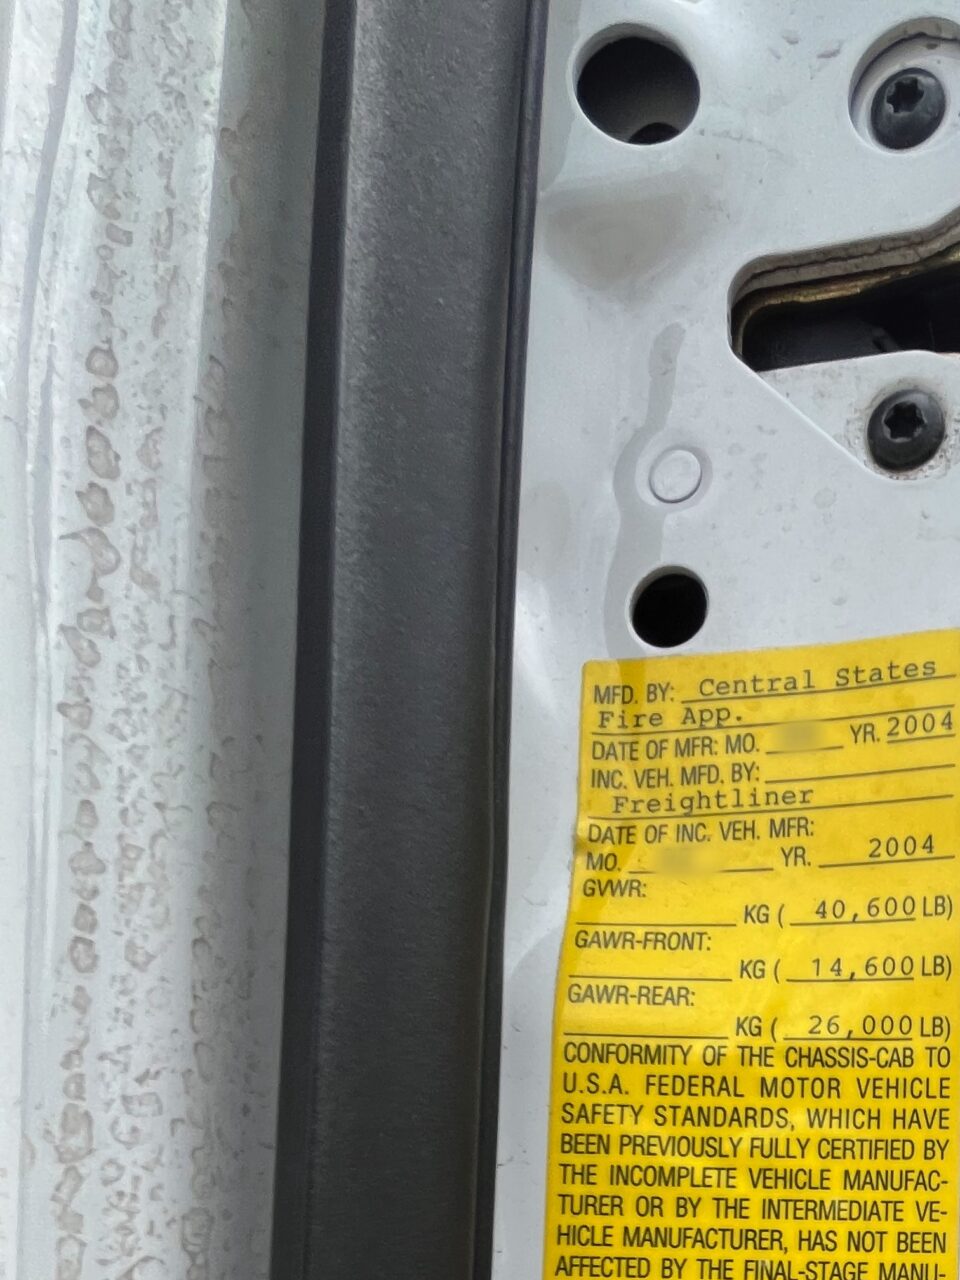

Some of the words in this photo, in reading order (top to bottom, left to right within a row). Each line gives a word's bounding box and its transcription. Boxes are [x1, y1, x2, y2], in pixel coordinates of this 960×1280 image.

[594, 685, 638, 705] MFD.
[647, 683, 674, 702] BY:
[699, 670, 816, 696] Central
[836, 660, 936, 686] States
[599, 710, 663, 729] Fire
[682, 708, 743, 729] App.
[592, 741, 638, 761] DATE
[646, 739, 668, 759] OF
[675, 736, 718, 757] MFR:
[726, 734, 760, 755] MO.
[850, 723, 880, 744] YR.
[887, 711, 954, 736] 2004
[591, 770, 627, 790] INC.
[635, 767, 674, 787] VEH.
[681, 765, 724, 785] MFD.
[732, 762, 760, 782] BY:
[613, 787, 814, 814] Freightliner
[589, 824, 637, 844] DATE
[645, 822, 668, 843] OF
[676, 821, 710, 842] INC.
[720, 819, 760, 841] VEH.
[769, 816, 814, 838] MFR:
[586, 852, 620, 872] MO.
[781, 846, 810, 868] YR.
[869, 835, 935, 859] 2004
[583, 879, 647, 897] GVWR:
[744, 904, 769, 923] KG
[815, 896, 916, 921] 40,600
[922, 895, 953, 920] LB)
[575, 930, 712, 951] GAWR-FRONT:
[740, 959, 765, 979] KG
[813, 956, 914, 981] 14,600
[921, 955, 951, 980] LB)
[568, 984, 695, 1007] GAWR-REAR:
[736, 1016, 762, 1036] KG
[809, 1015, 912, 1039] 26,000
[920, 1015, 950, 1040] LB)
[564, 1043, 693, 1065] CONFORMITY
[703, 1046, 727, 1066] OF
[737, 1046, 774, 1067] THE
[785, 1046, 914, 1069] CHASSIS-CAB
[926, 1047, 950, 1069] TO
[563, 1073, 629, 1096] U.S.A.
[646, 1075, 744, 1098] FEDERAL
[760, 1076, 841, 1099] MOTOR
[857, 1077, 950, 1099] VEHICLE
[561, 1103, 643, 1125] SAFETY
[654, 1105, 795, 1131] STANDARDS,
[807, 1108, 881, 1129] WHICH
[892, 1108, 950, 1130] HAVE
[560, 1134, 610, 1155] BEEN
[619, 1135, 743, 1159] PREVIOUSLY
[749, 1137, 809, 1159] FULLY
[817, 1138, 915, 1160] CERTIFIED
[924, 1139, 949, 1161] BY
[559, 1164, 598, 1186] THE
[610, 1165, 737, 1189] INCOMPLETE
[748, 1168, 831, 1190] VEHICLE
[843, 1169, 948, 1192] MANUFAC-
[558, 1195, 623, 1217] TURER
[635, 1196, 664, 1218] OR
[676, 1198, 701, 1219] BY
[713, 1198, 749, 1220] THE
[761, 1198, 904, 1222] INTERMEDIATE
[916, 1201, 947, 1222] VE-
[557, 1225, 613, 1247] HICLE
[623, 1227, 788, 1255] MANUFACTURER,
[798, 1230, 837, 1252] HAS
[847, 1231, 887, 1252] NOT
[896, 1231, 947, 1253] BEEN
[554, 1256, 650, 1279] AFFECTED
[661, 1258, 686, 1279] BY
[696, 1258, 734, 1280] THE
